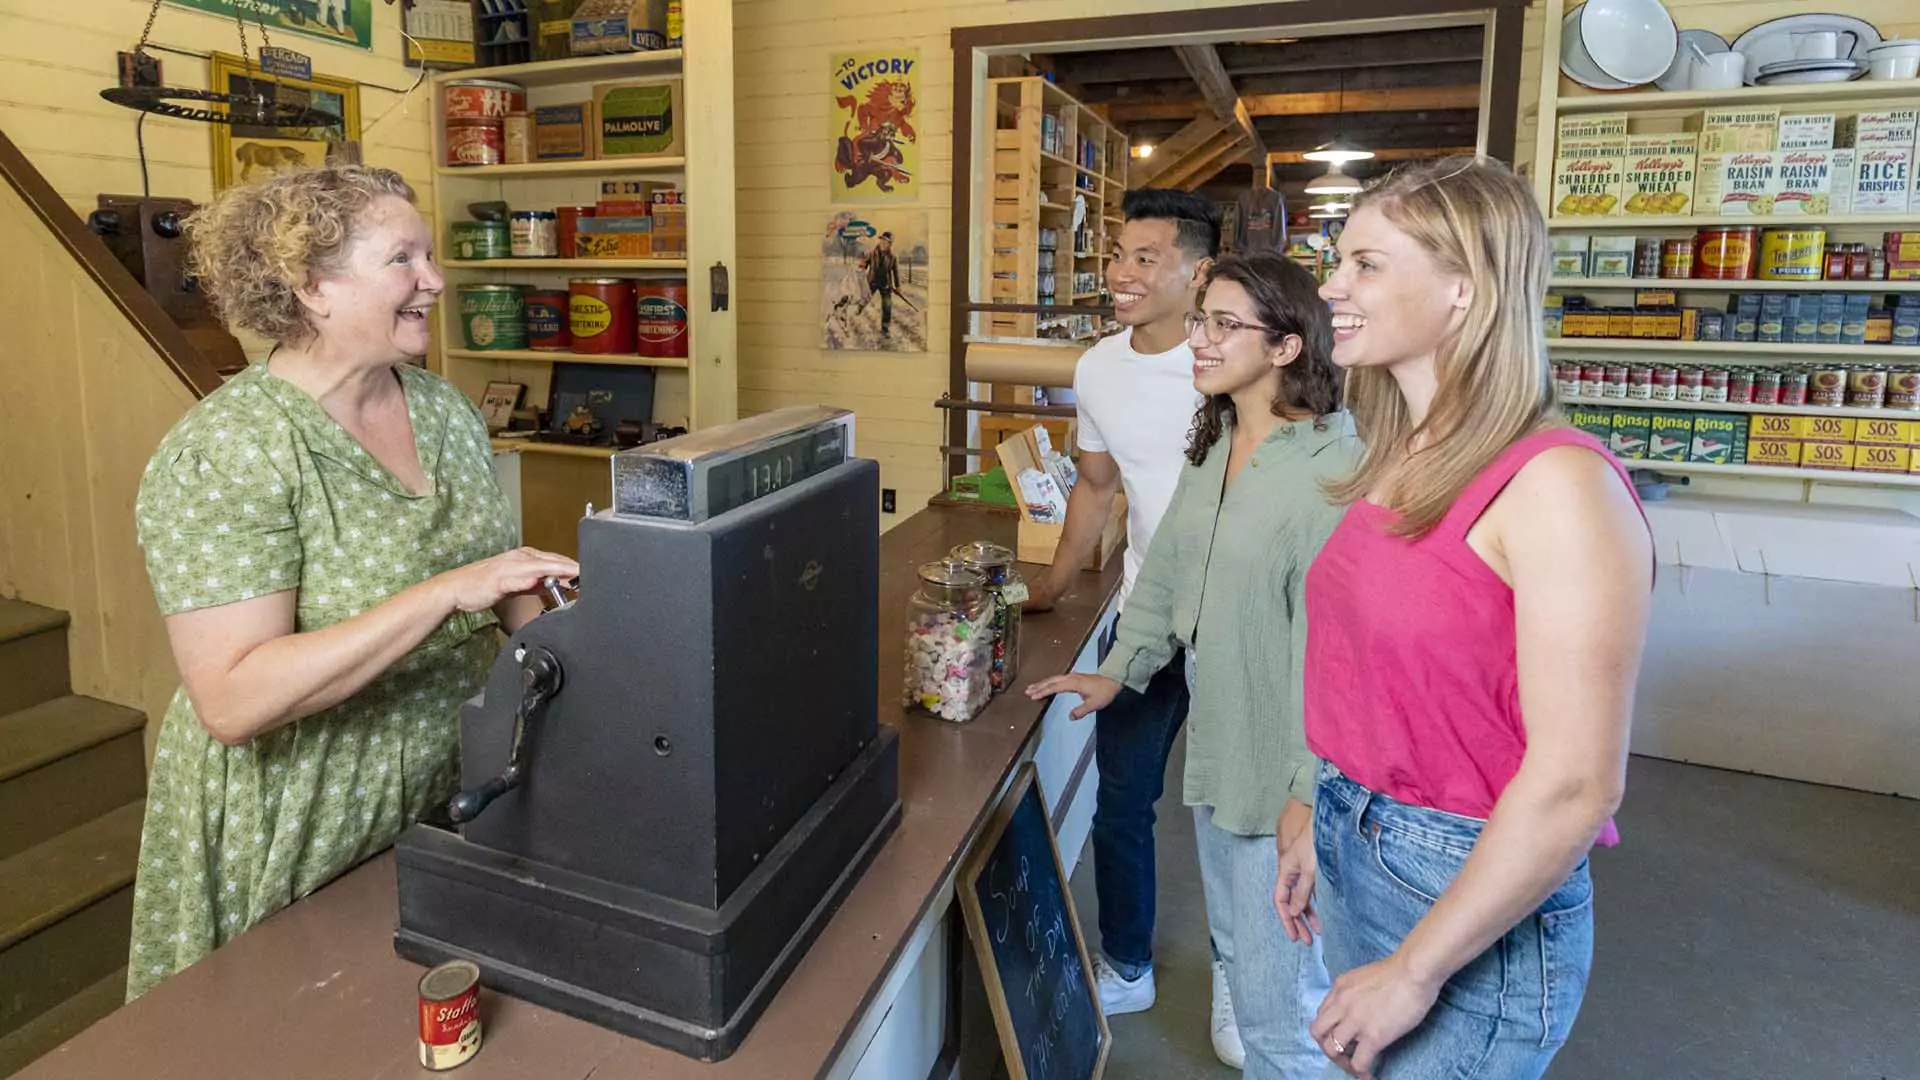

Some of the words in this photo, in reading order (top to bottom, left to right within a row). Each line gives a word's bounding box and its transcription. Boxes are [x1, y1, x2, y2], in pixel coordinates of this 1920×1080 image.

[840, 58, 914, 90] VICTORY
[604, 120, 660, 133] PALMOLIVE
[1561, 127, 1598, 138] SHREDDED
[1600, 125, 1624, 135] WHEAT
[1600, 148, 1624, 157] WHEAT
[1629, 147, 1667, 156] SHREDDED
[1670, 145, 1695, 155] WHEAT
[1862, 150, 1906, 163] Kellogg's
[1635, 158, 1684, 171] Kellogg's
[1730, 153, 1773, 166] Kellogg's
[1783, 152, 1827, 166] Kellogg's
[1566, 160, 1614, 173] Kellogg's
[1727, 166, 1773, 180] RAISIN
[1780, 165, 1828, 179] RAISIN
[1860, 162, 1907, 180] RICE
[1558, 173, 1620, 185] SHREDDED
[1626, 171, 1692, 183] SHREDDED
[1786, 178, 1819, 189] BRAN
[1569, 183, 1608, 195] WHEAT
[1638, 182, 1678, 193] WHEAT
[1733, 180, 1766, 190] BRAN
[1858, 180, 1906, 192] KRISPIES
[1574, 411, 1611, 427] Rinso
[1612, 414, 1650, 428] Rinso
[1652, 416, 1691, 431] Rinso
[1694, 418, 1734, 433] Rinso
[1762, 417, 1790, 432] SOS
[1813, 419, 1842, 433] SOS
[1867, 421, 1897, 436] SOS
[1759, 442, 1788, 456] SOS
[1814, 445, 1843, 460] SOS
[1867, 448, 1896, 463] SOS
